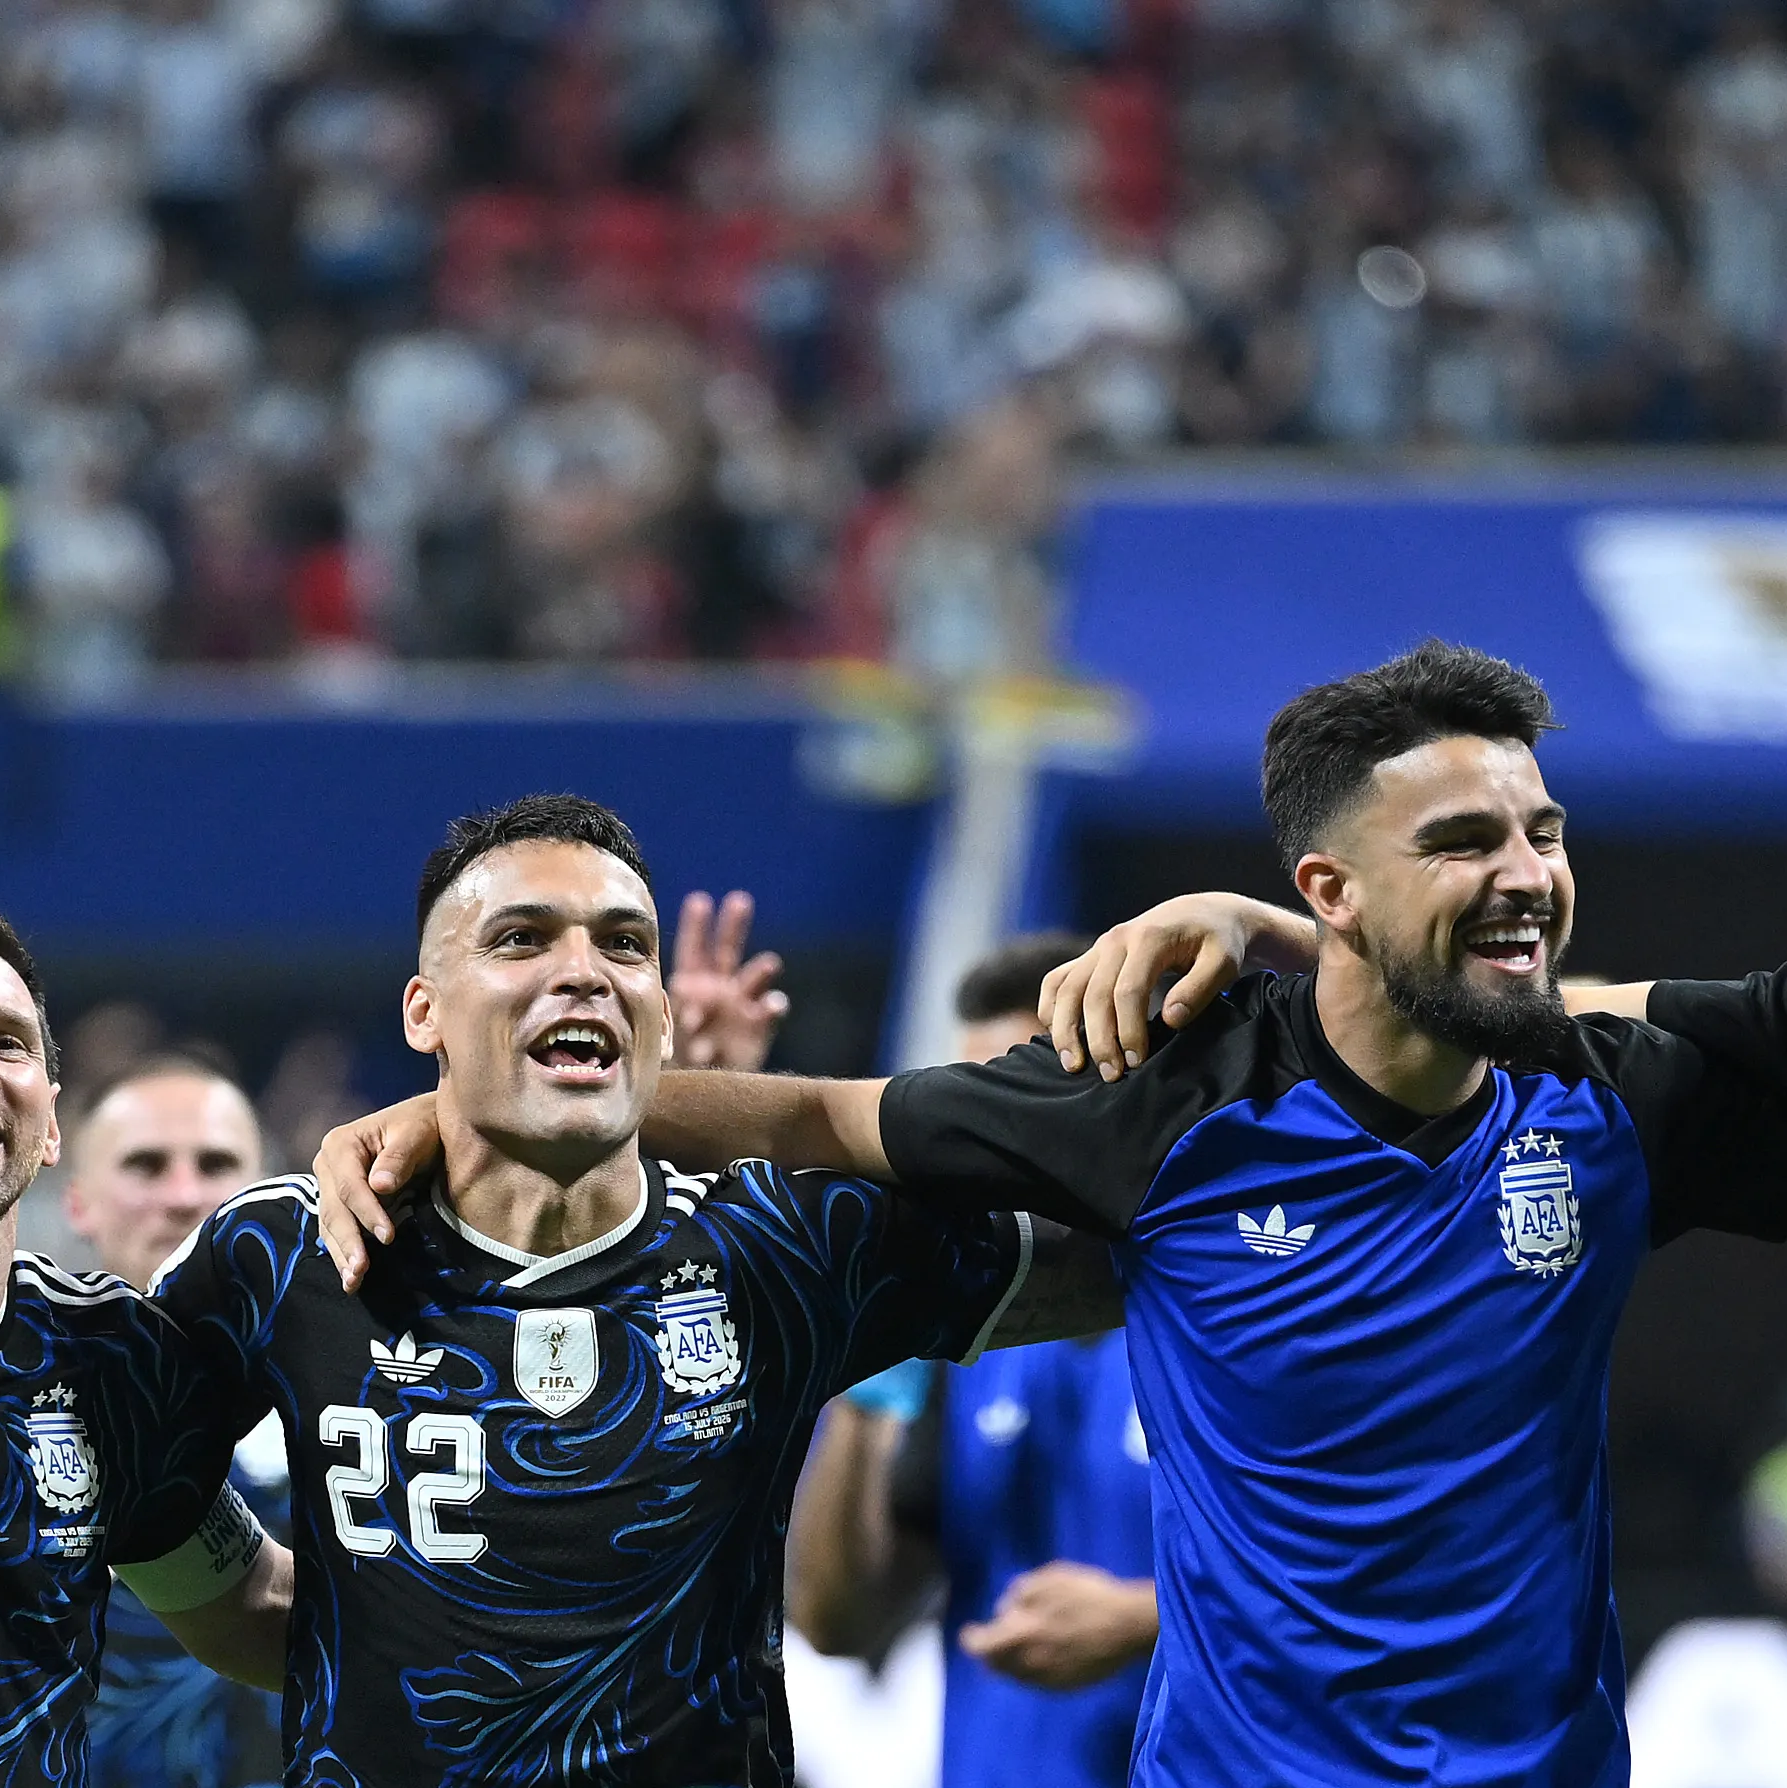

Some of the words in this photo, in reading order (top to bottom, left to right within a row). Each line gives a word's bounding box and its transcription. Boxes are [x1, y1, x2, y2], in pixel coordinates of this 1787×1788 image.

[1521, 1194, 1564, 1242] AFA
[677, 1317, 722, 1363] AFA
[539, 1376, 574, 1388] FIFA
[664, 1410, 697, 1425] ENGLAND
[699, 1407, 709, 1418] VS
[711, 1399, 747, 1415] ARGENTINA
[684, 1421, 692, 1431] 15
[694, 1418, 711, 1430] JULY
[713, 1414, 731, 1426] 2026
[694, 1426, 724, 1440] ATLANTA
[48, 1438, 86, 1482] AFA
[318, 1404, 488, 1564] 22
